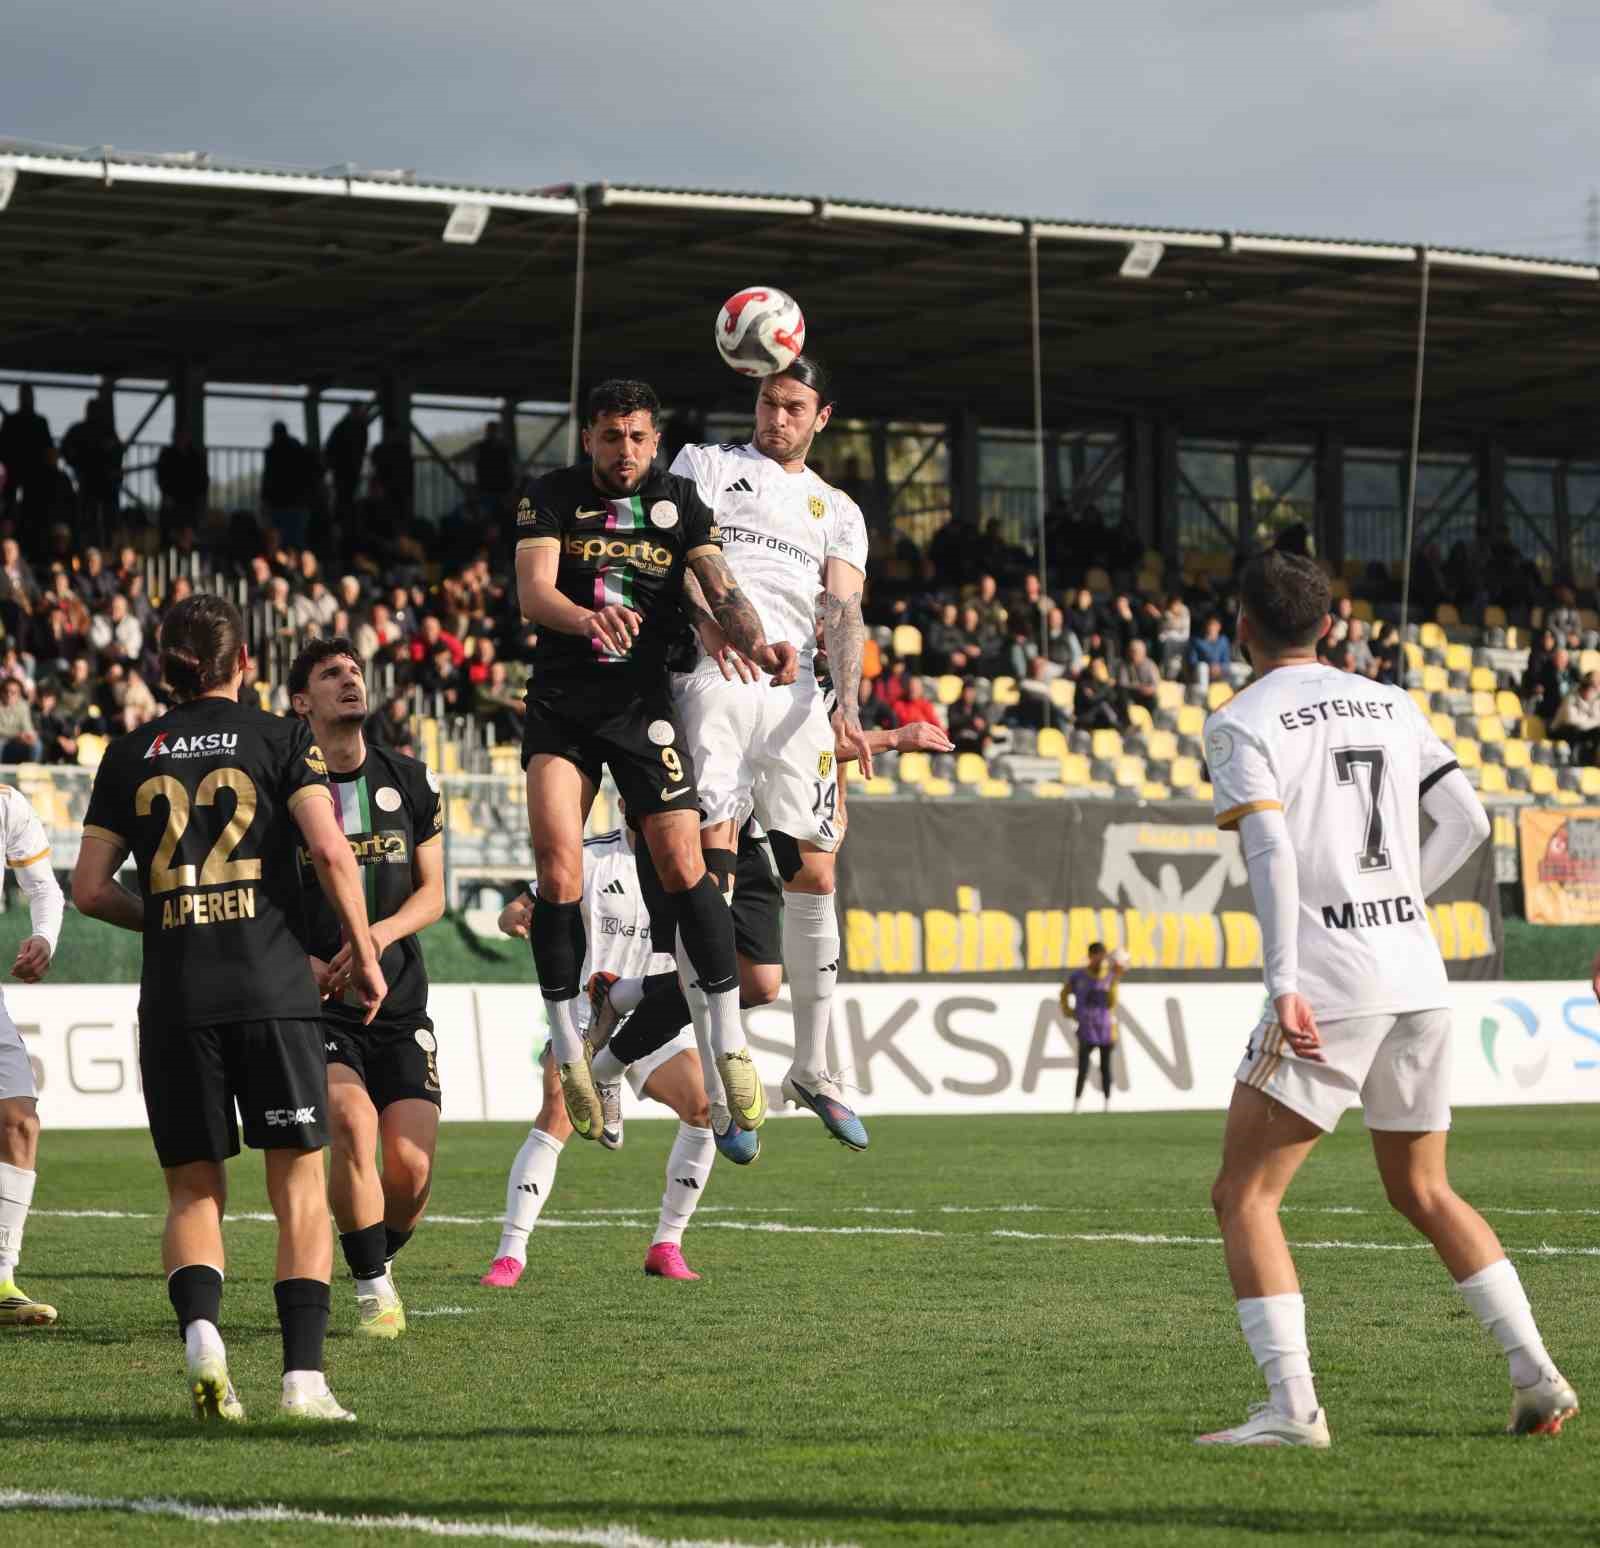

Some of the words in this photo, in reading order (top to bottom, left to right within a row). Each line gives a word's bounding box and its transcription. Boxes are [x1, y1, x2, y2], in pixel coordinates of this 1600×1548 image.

[733, 527, 811, 568] kardemir
[1280, 699, 1394, 730] ESTENET
[171, 733, 238, 752] AKSU
[661, 747, 684, 782] 9
[812, 782, 836, 820] 14
[1329, 745, 1392, 874] 7
[135, 767, 262, 894] 22
[162, 887, 256, 930] APEREN
[846, 908, 922, 974] BU
[923, 885, 1024, 974] BİR
